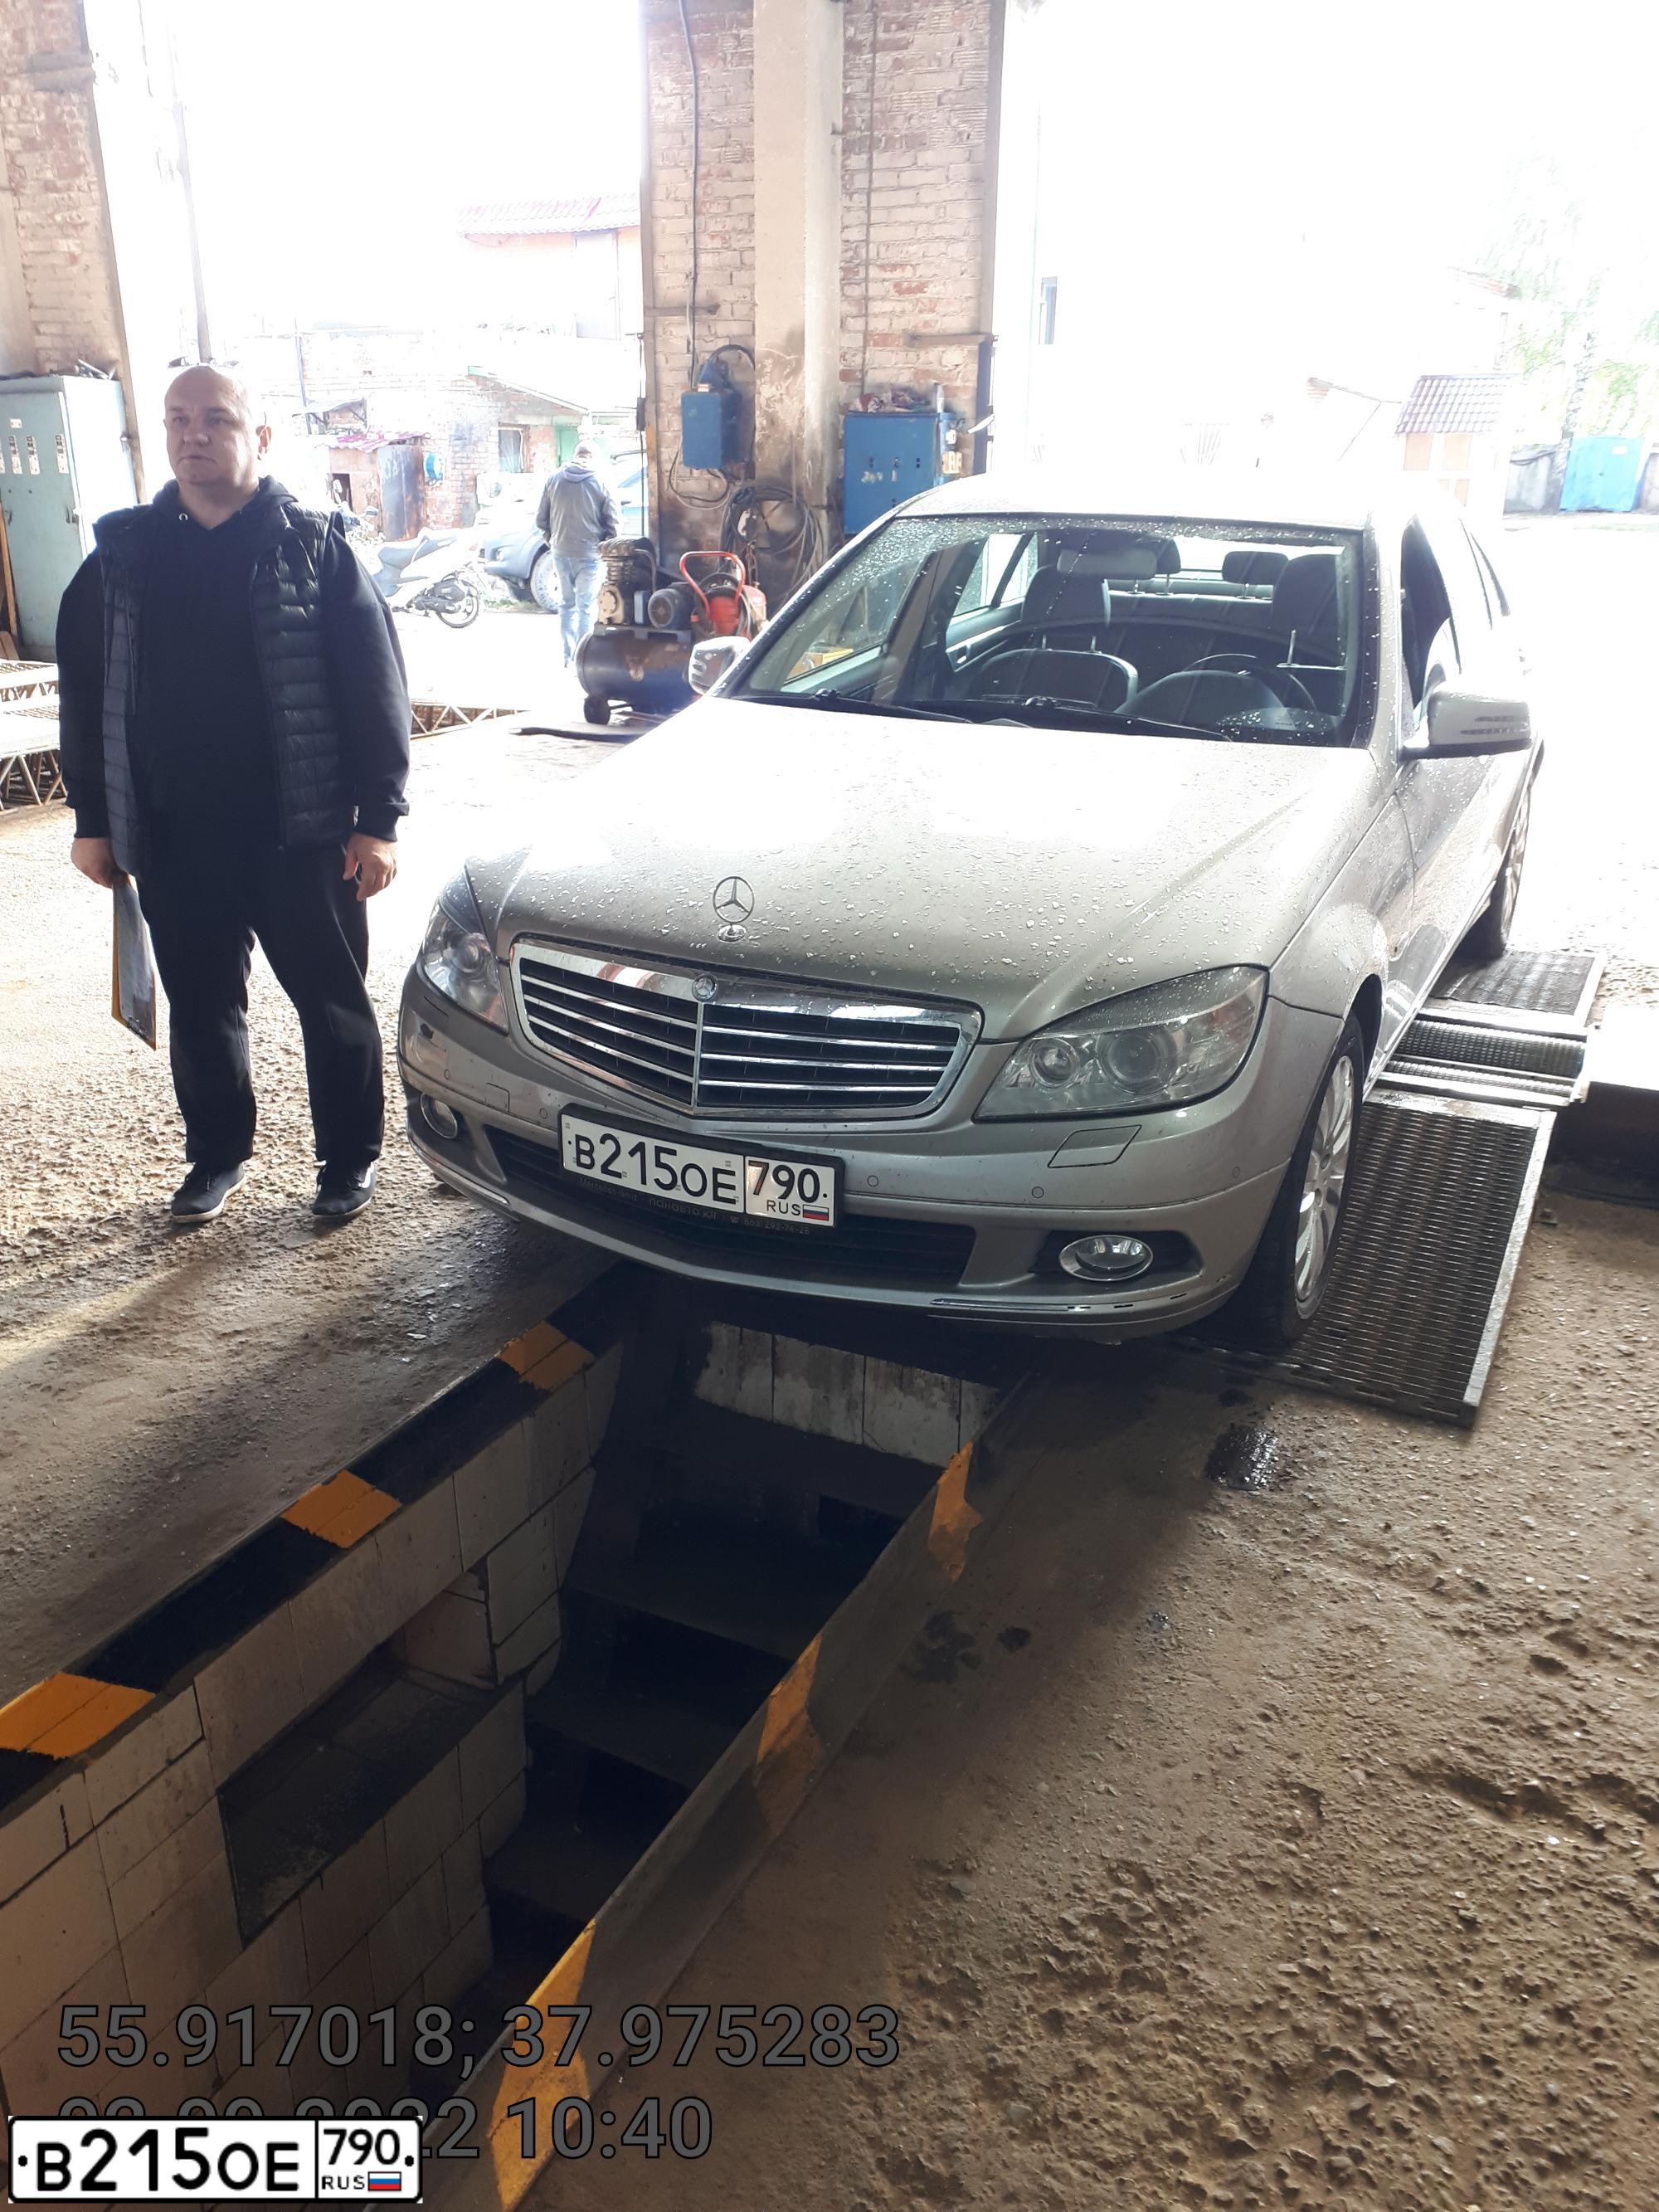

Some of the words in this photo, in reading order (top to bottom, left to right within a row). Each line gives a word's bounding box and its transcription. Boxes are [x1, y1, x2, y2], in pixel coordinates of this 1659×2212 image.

[574, 1133, 737, 1205] В215ОЕ
[748, 1160, 820, 1204] 790
[766, 1199, 801, 1216] RUS
